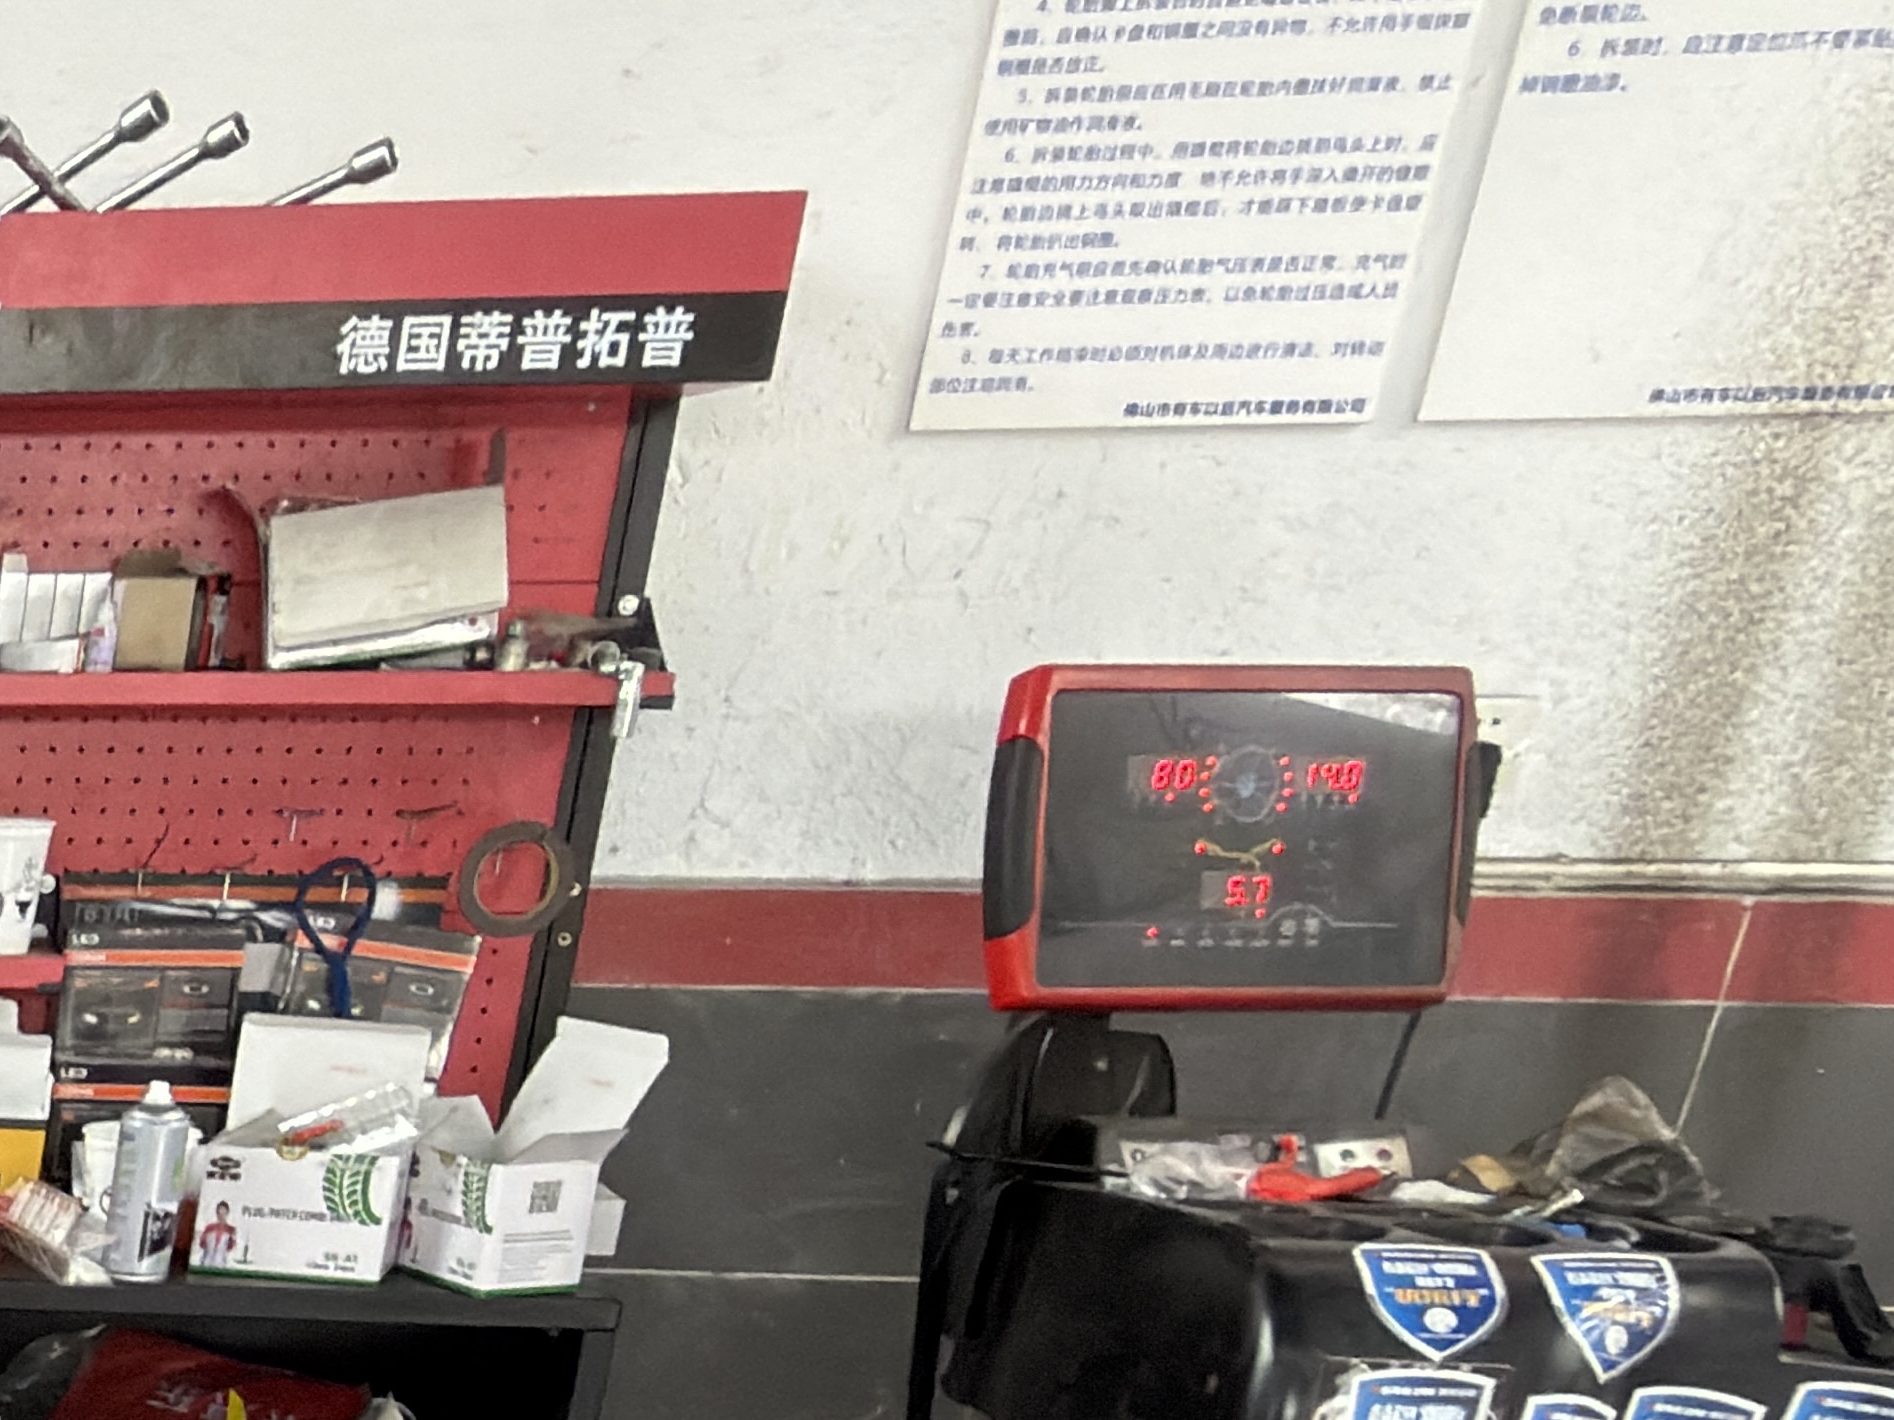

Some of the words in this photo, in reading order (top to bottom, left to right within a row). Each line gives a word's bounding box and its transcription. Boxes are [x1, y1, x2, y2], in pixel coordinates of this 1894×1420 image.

[336, 305, 696, 375] 德国蒂普拓普
